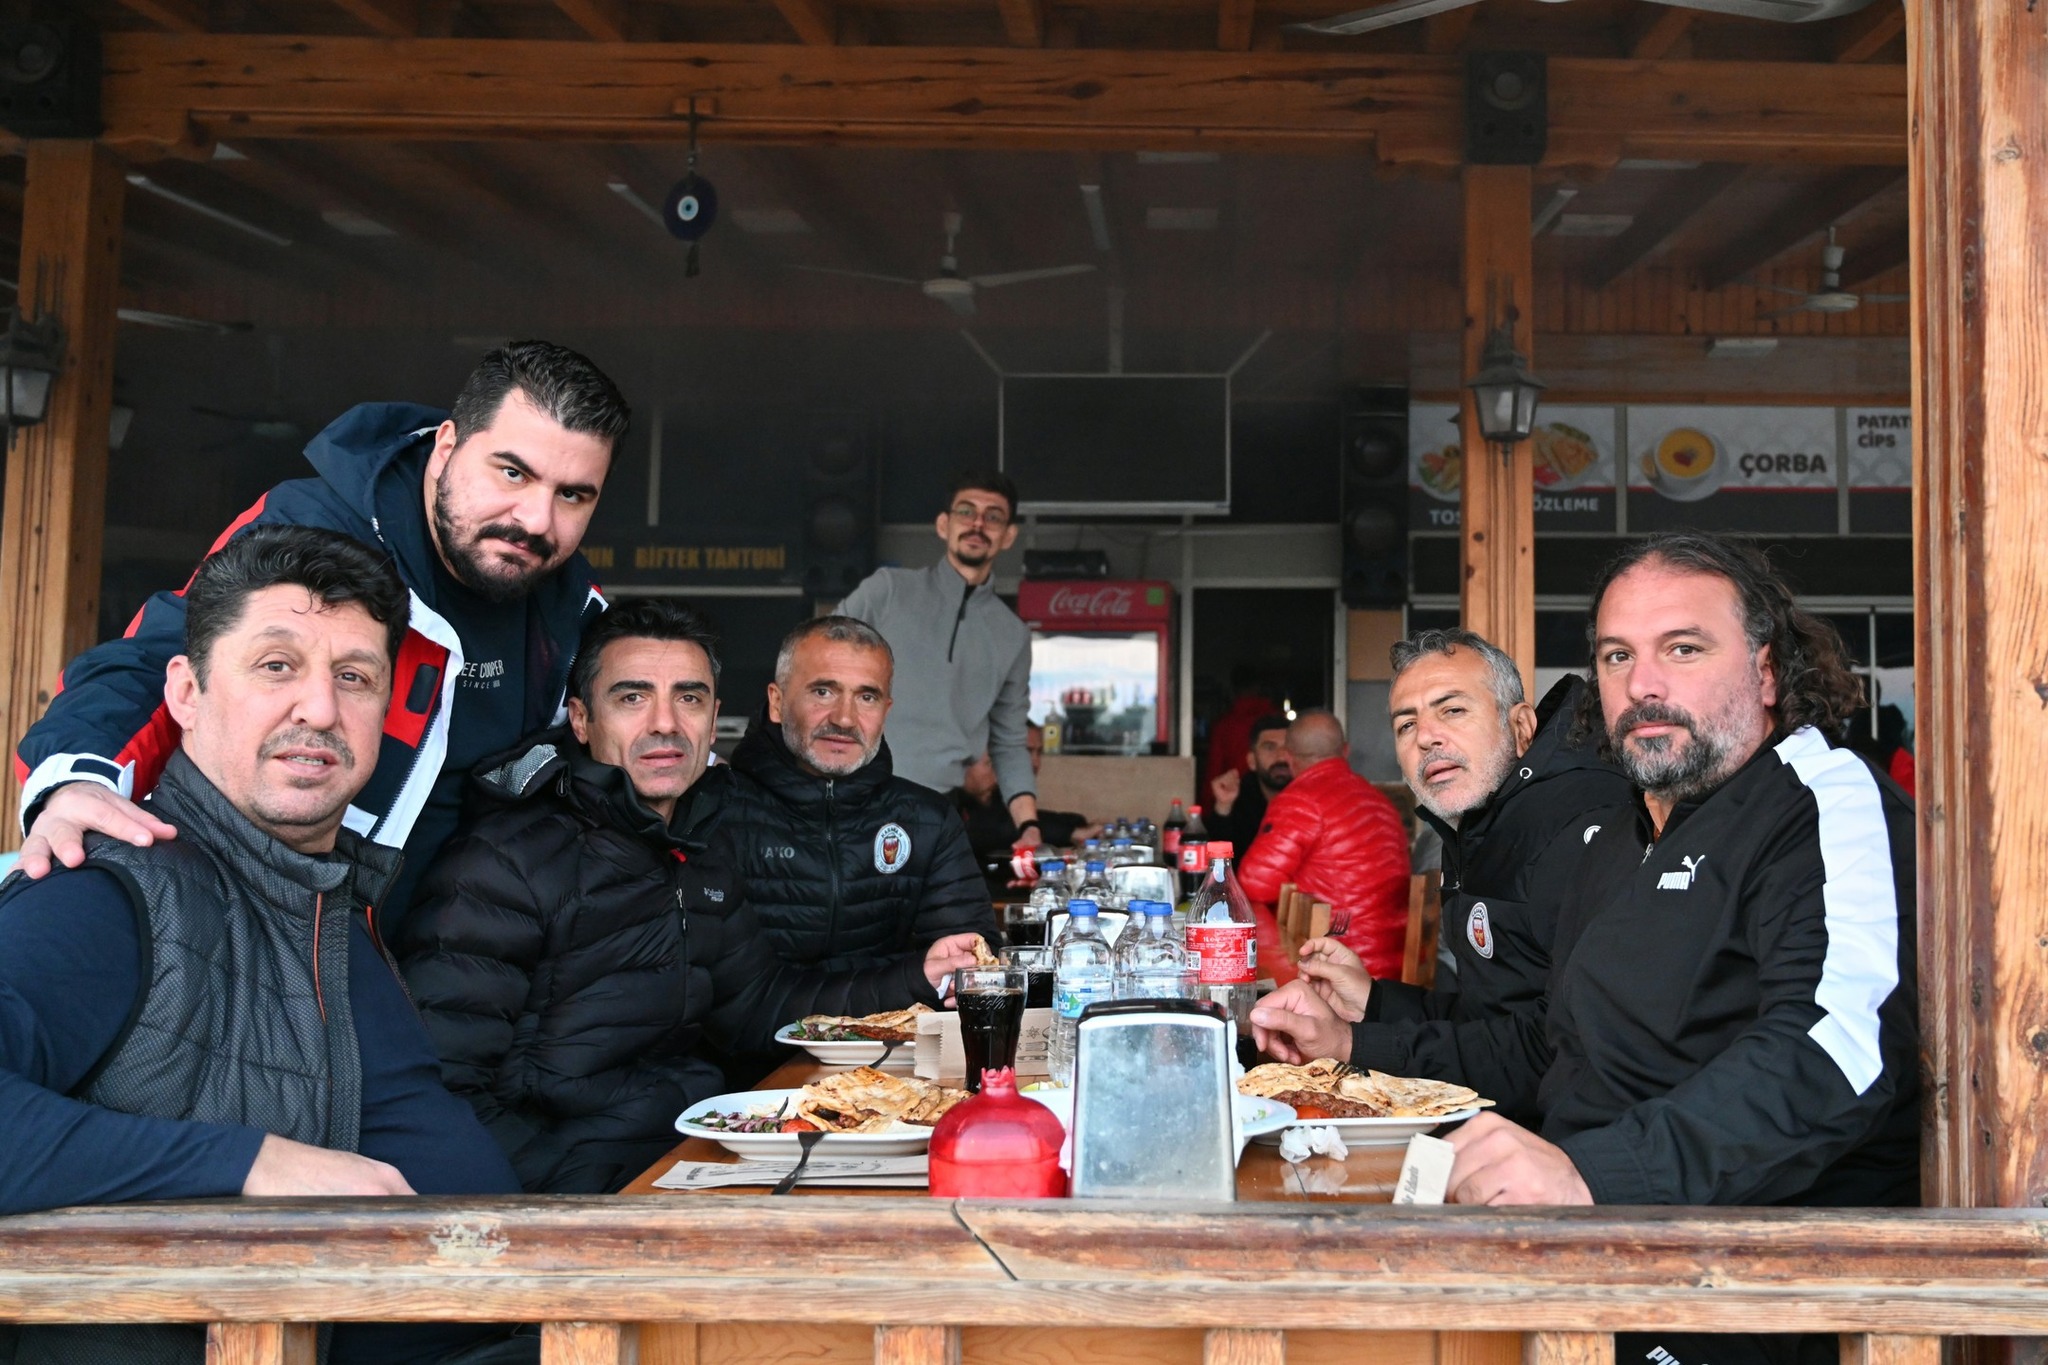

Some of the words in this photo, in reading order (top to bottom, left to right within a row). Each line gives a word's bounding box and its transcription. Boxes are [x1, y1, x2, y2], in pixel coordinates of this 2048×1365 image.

[1857, 414, 1911, 430] PATAT
[1857, 430, 1896, 449] CİPS
[1739, 453, 1827, 479] ÇORBA
[459, 662, 479, 678] EE
[463, 680, 490, 690] SINCE
[1656, 871, 1692, 890] PUMA
